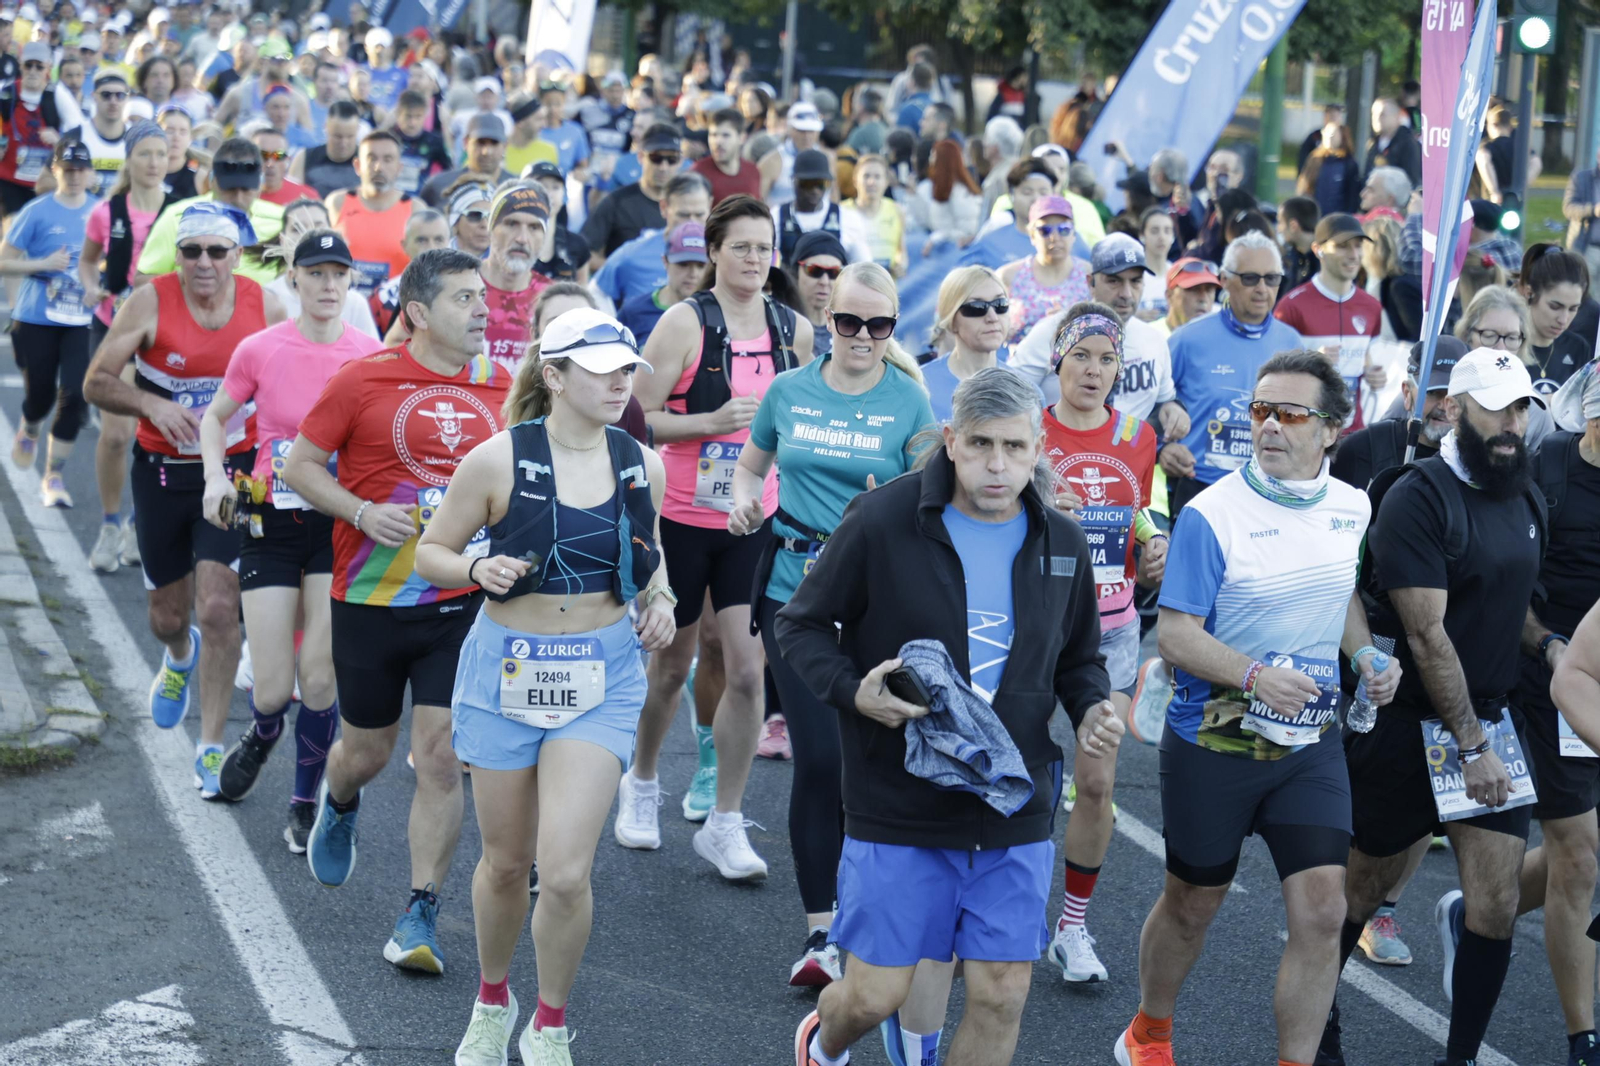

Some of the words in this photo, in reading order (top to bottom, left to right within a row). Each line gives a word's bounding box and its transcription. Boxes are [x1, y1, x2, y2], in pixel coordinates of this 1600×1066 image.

[1153, 0, 1234, 85] Cruz
[170, 380, 219, 391] MAIDEN
[790, 405, 822, 417] stadium
[829, 419, 848, 428] 2024
[867, 415, 895, 423] VITAMIN
[793, 424, 852, 446] Midnight
[853, 433, 880, 449] Run
[1211, 439, 1227, 454] EL
[813, 447, 851, 459] HELSINKI
[272, 479, 291, 491] IN
[712, 481, 732, 496] PE
[520, 491, 547, 501] SALOMON
[1080, 511, 1124, 521] ZURICH
[1086, 533, 1105, 544] 669
[1250, 529, 1279, 539] FASTER
[1091, 548, 1107, 564] IA
[536, 644, 592, 656] ZURICH
[1300, 663, 1334, 677] ZURICH
[535, 671, 571, 683] 12494
[527, 689, 577, 707] ELLIE
[1432, 759, 1526, 793] BANRO
